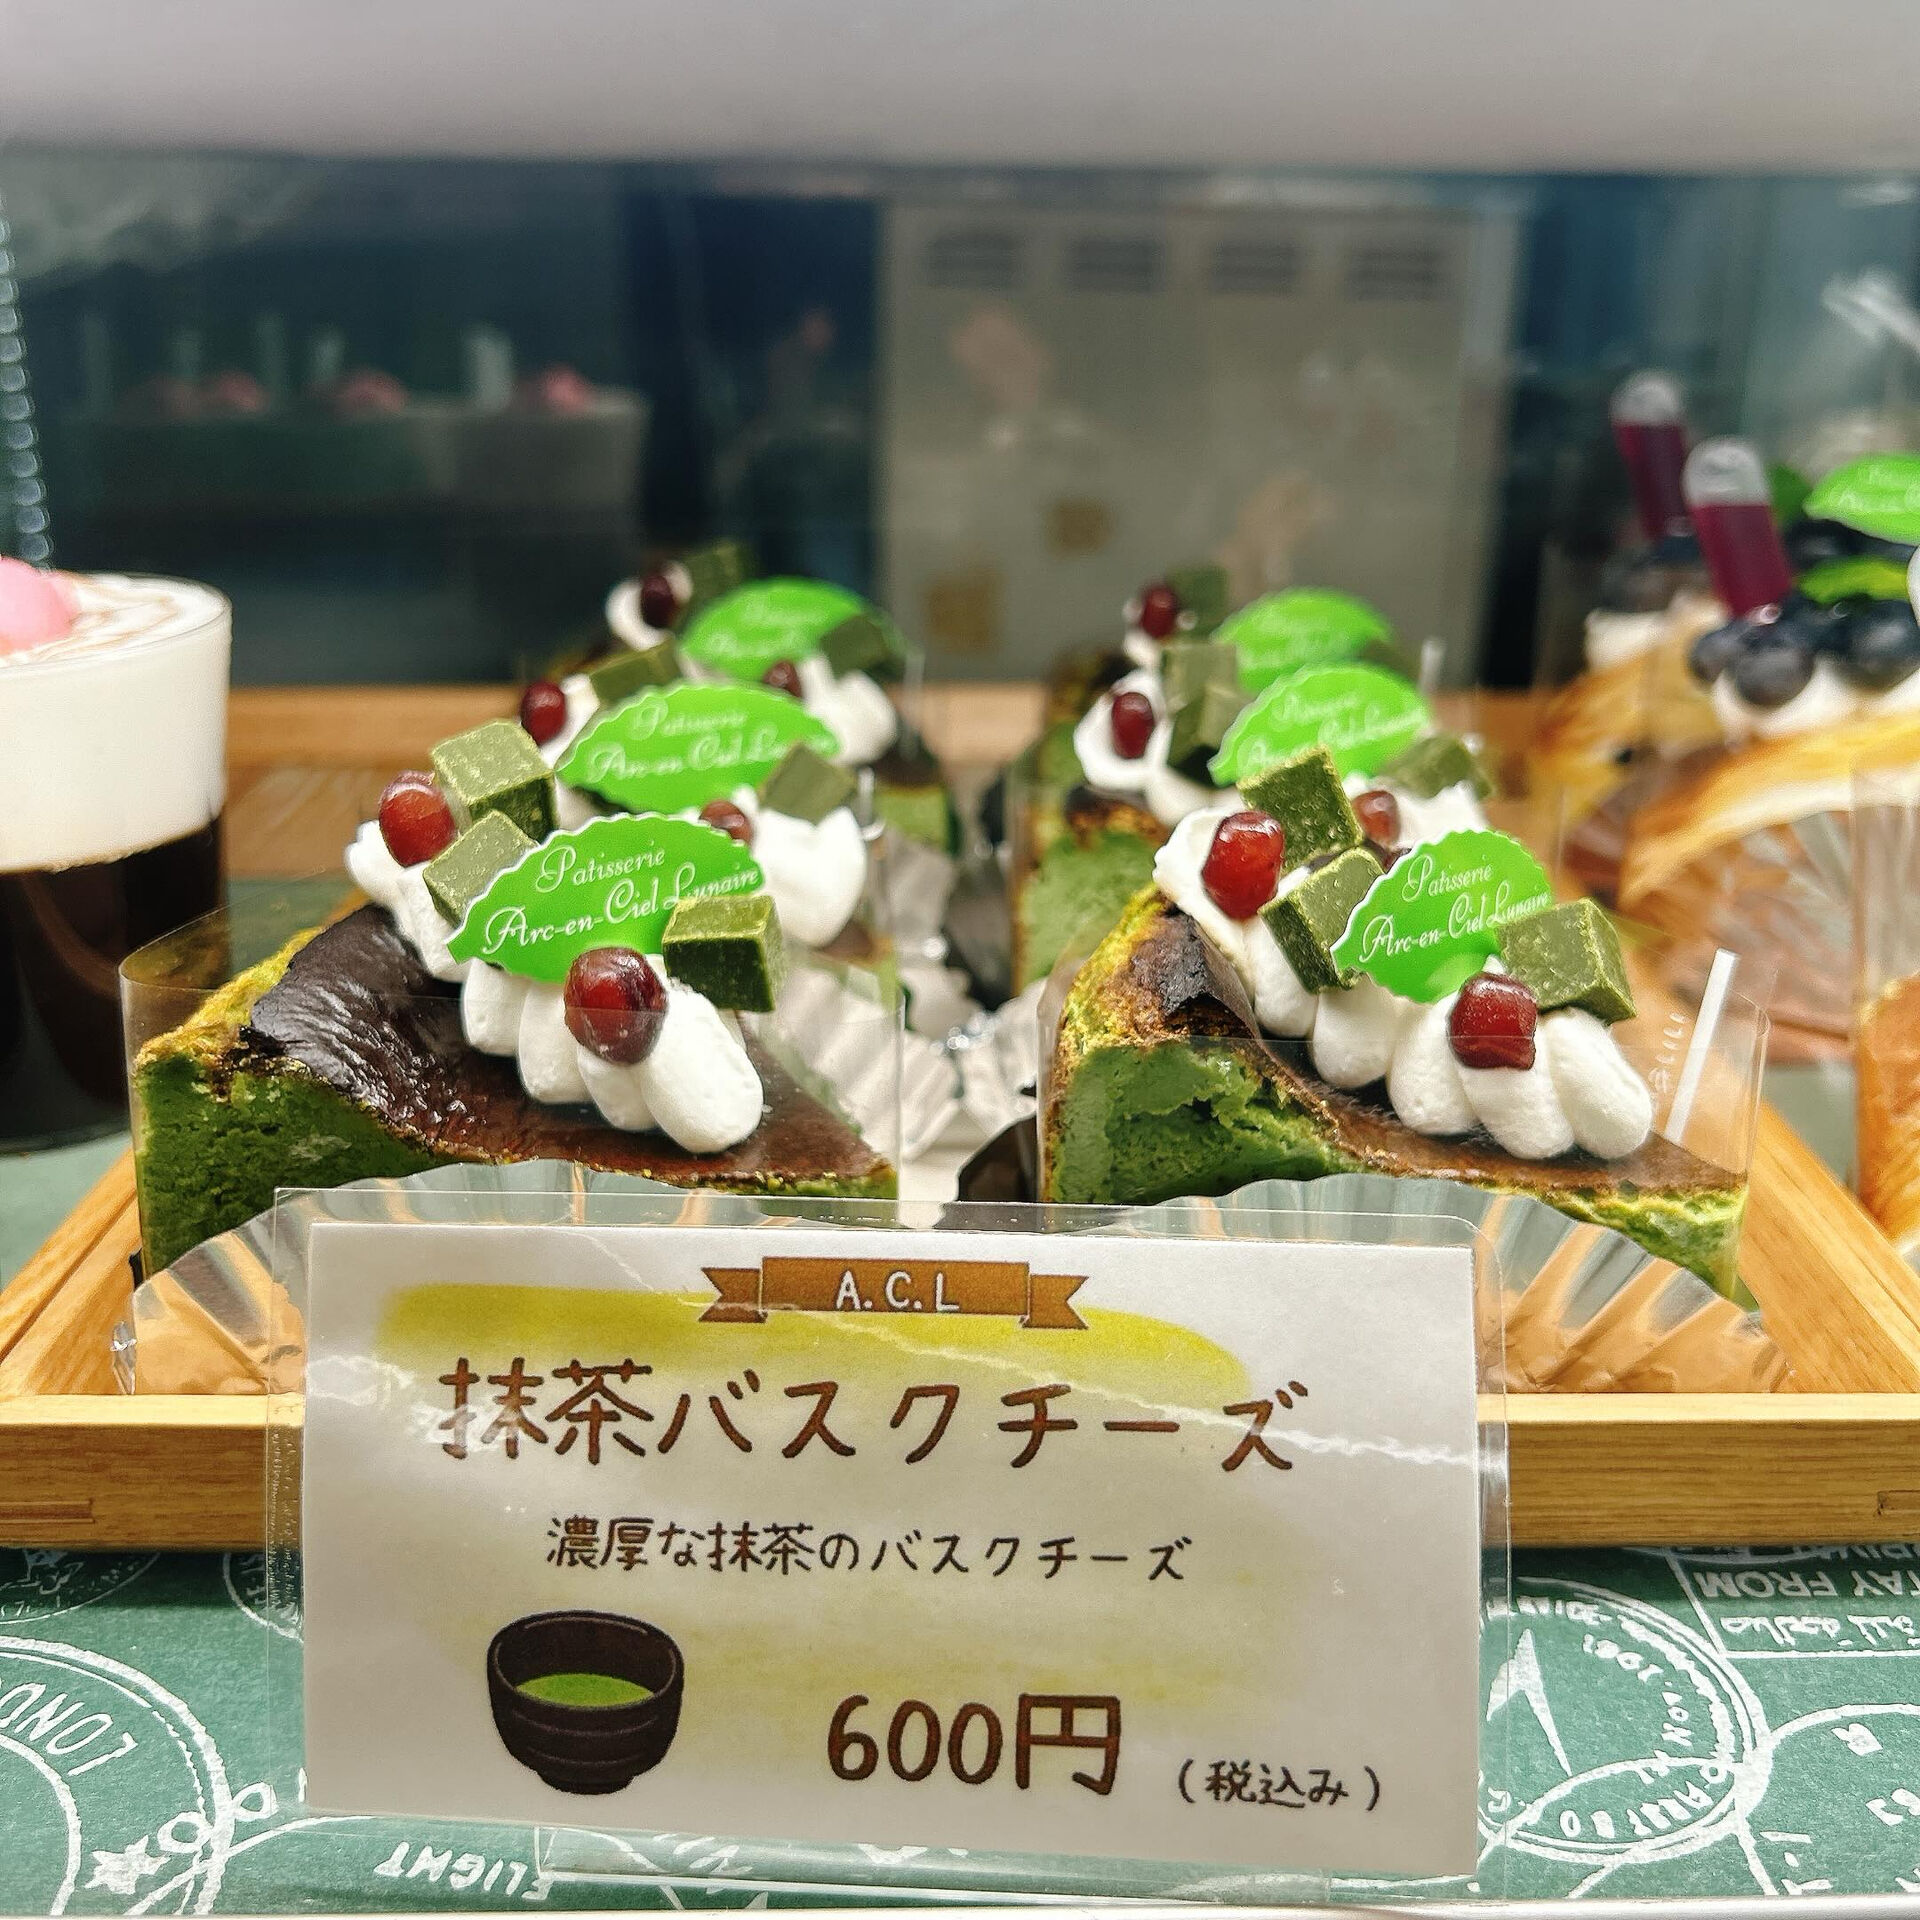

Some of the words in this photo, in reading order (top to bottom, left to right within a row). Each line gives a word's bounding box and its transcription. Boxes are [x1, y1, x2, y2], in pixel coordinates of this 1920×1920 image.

[535, 839, 666, 893] Patisserie
[1401, 853, 1494, 903] Patisserie
[482, 876, 659, 955] Arc-en-Ciel
[1358, 891, 1487, 963] Arc-en-Ciel
[835, 1270, 960, 1313] A.C.L
[438, 1356, 1309, 1473] 抹茶バスクチーズ
[546, 1514, 1193, 1581] 濃厚な抹茶のバスクチーズ
[1692, 1570, 1838, 1599] FROM
[827, 1693, 1121, 1795] 600円
[1178, 1758, 1382, 1812] (税込み)
[373, 1841, 553, 1901] FLIGHT
